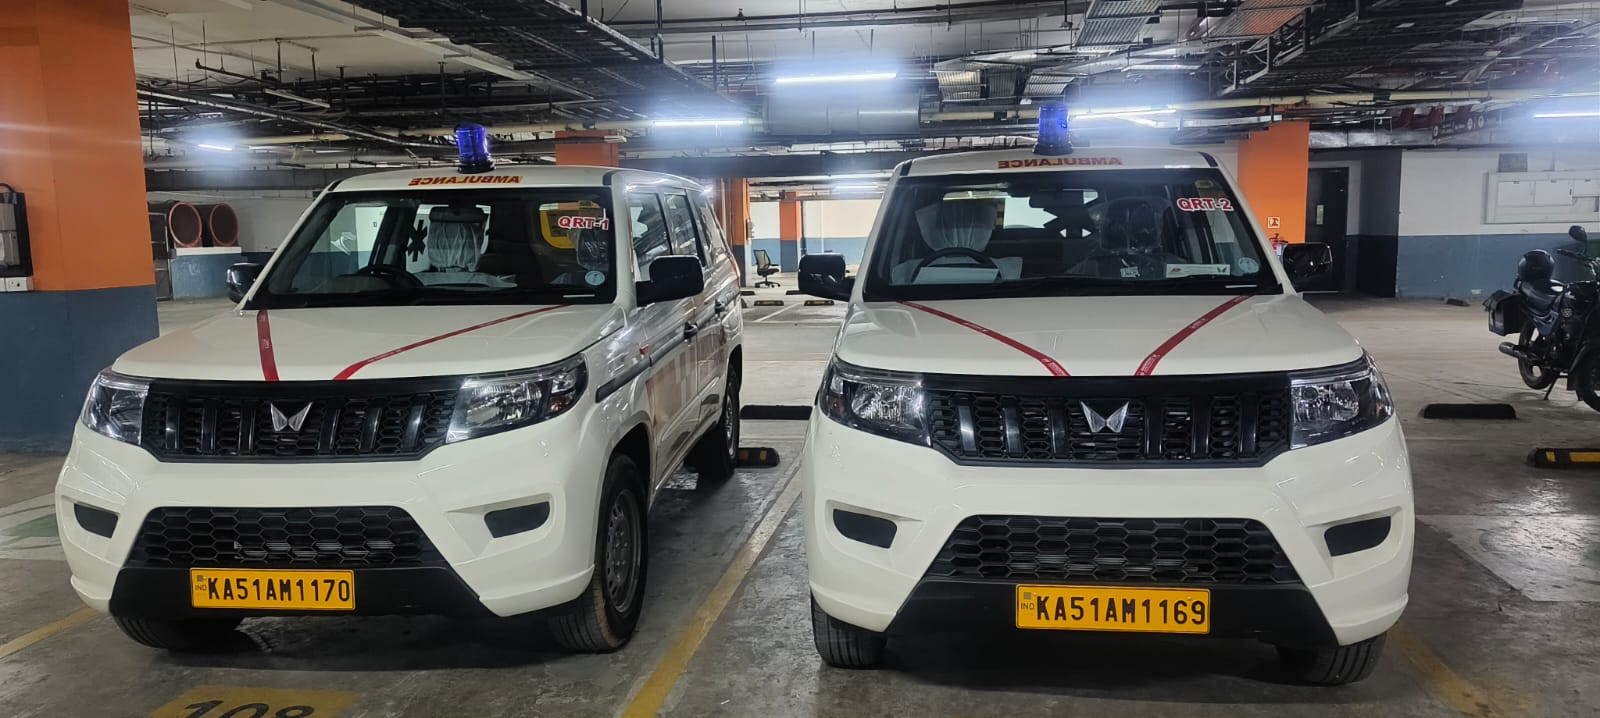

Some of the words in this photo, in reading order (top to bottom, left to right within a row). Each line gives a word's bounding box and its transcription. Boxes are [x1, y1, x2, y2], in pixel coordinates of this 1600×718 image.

[1177, 198, 1234, 211] QRT-2
[558, 216, 609, 230] QRT-1
[207, 577, 350, 602] KA51AM1170
[1020, 602, 1035, 610] IND
[1036, 595, 1206, 625] KA51AM1169
